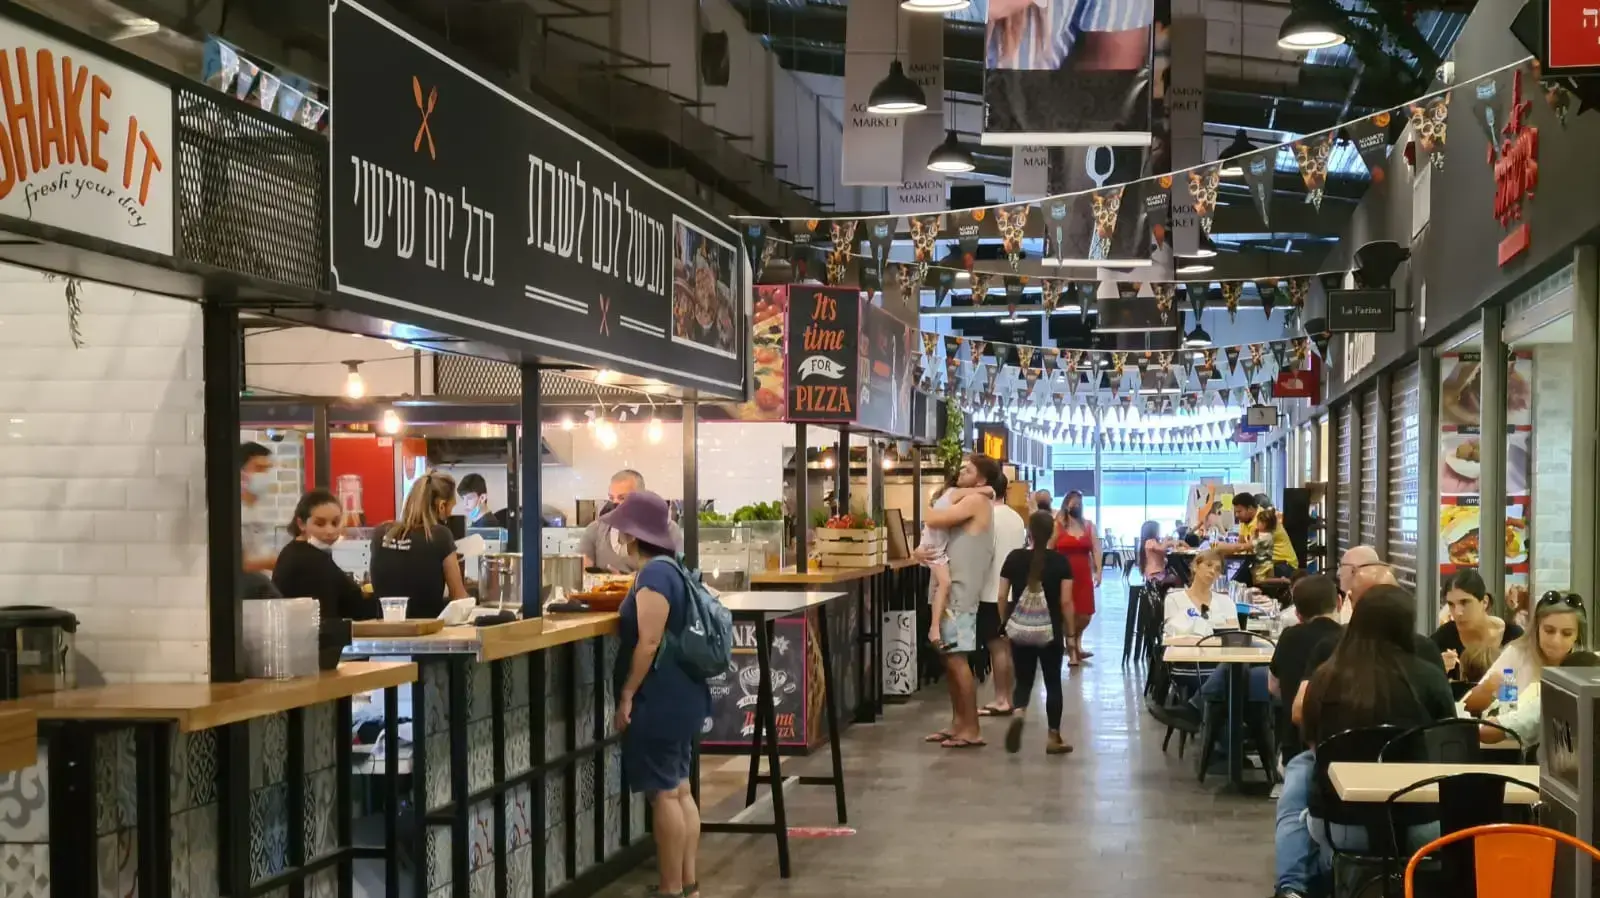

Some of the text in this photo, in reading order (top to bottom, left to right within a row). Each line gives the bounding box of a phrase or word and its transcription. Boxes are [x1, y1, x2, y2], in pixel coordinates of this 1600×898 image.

[852, 118, 898, 128] MARKET
[123, 115, 162, 207] IT
[23, 171, 147, 228] fresh your day
[899, 194, 940, 204] MARKET
[351, 155, 495, 287] בכל יום שישי
[527, 153, 665, 296] מבשל לכם לשבת
[812, 292, 837, 321] It's
[1342, 305, 1382, 315] La Farina
[803, 323, 845, 351] time
[811, 359, 831, 372] FOR
[795, 385, 851, 412] PIZZA
